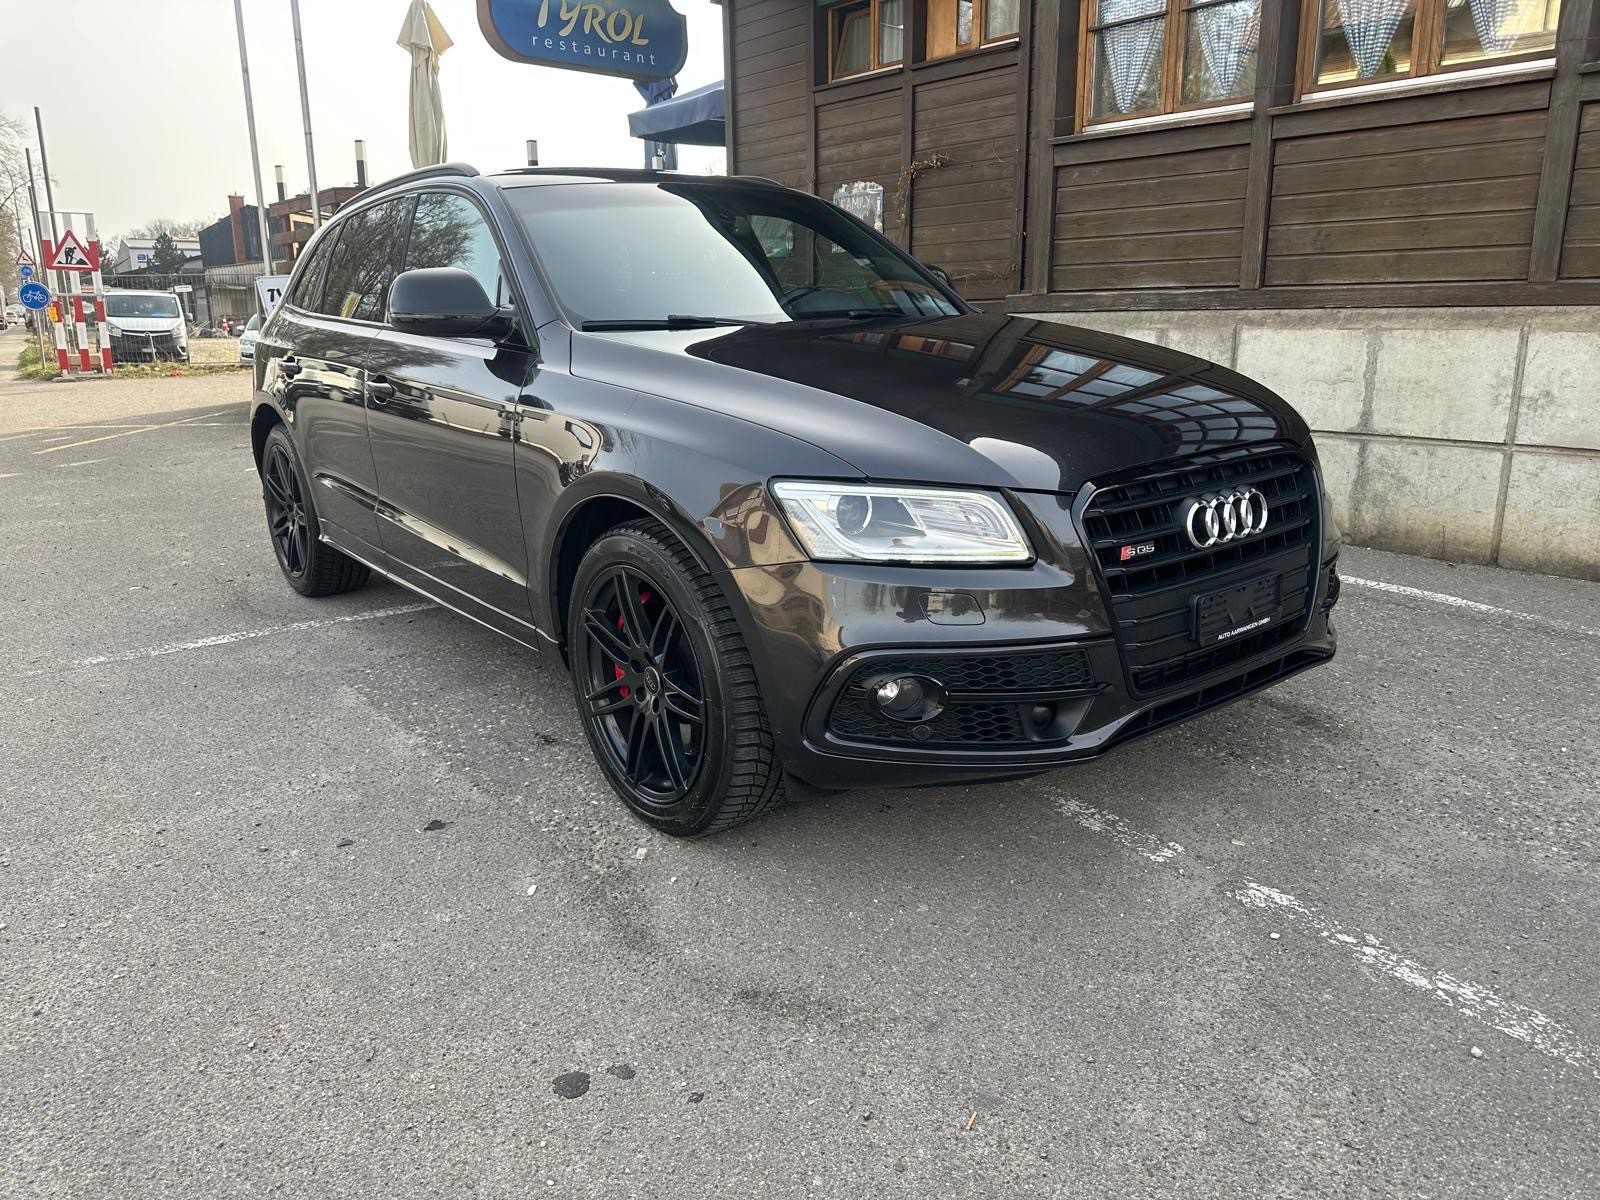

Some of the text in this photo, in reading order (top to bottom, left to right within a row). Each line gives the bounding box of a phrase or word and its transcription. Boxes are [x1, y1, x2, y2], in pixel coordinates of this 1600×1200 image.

[532, 35, 656, 65] restaurant
[1126, 544, 1155, 557] SQ5
[1217, 631, 1231, 641] AUTO
